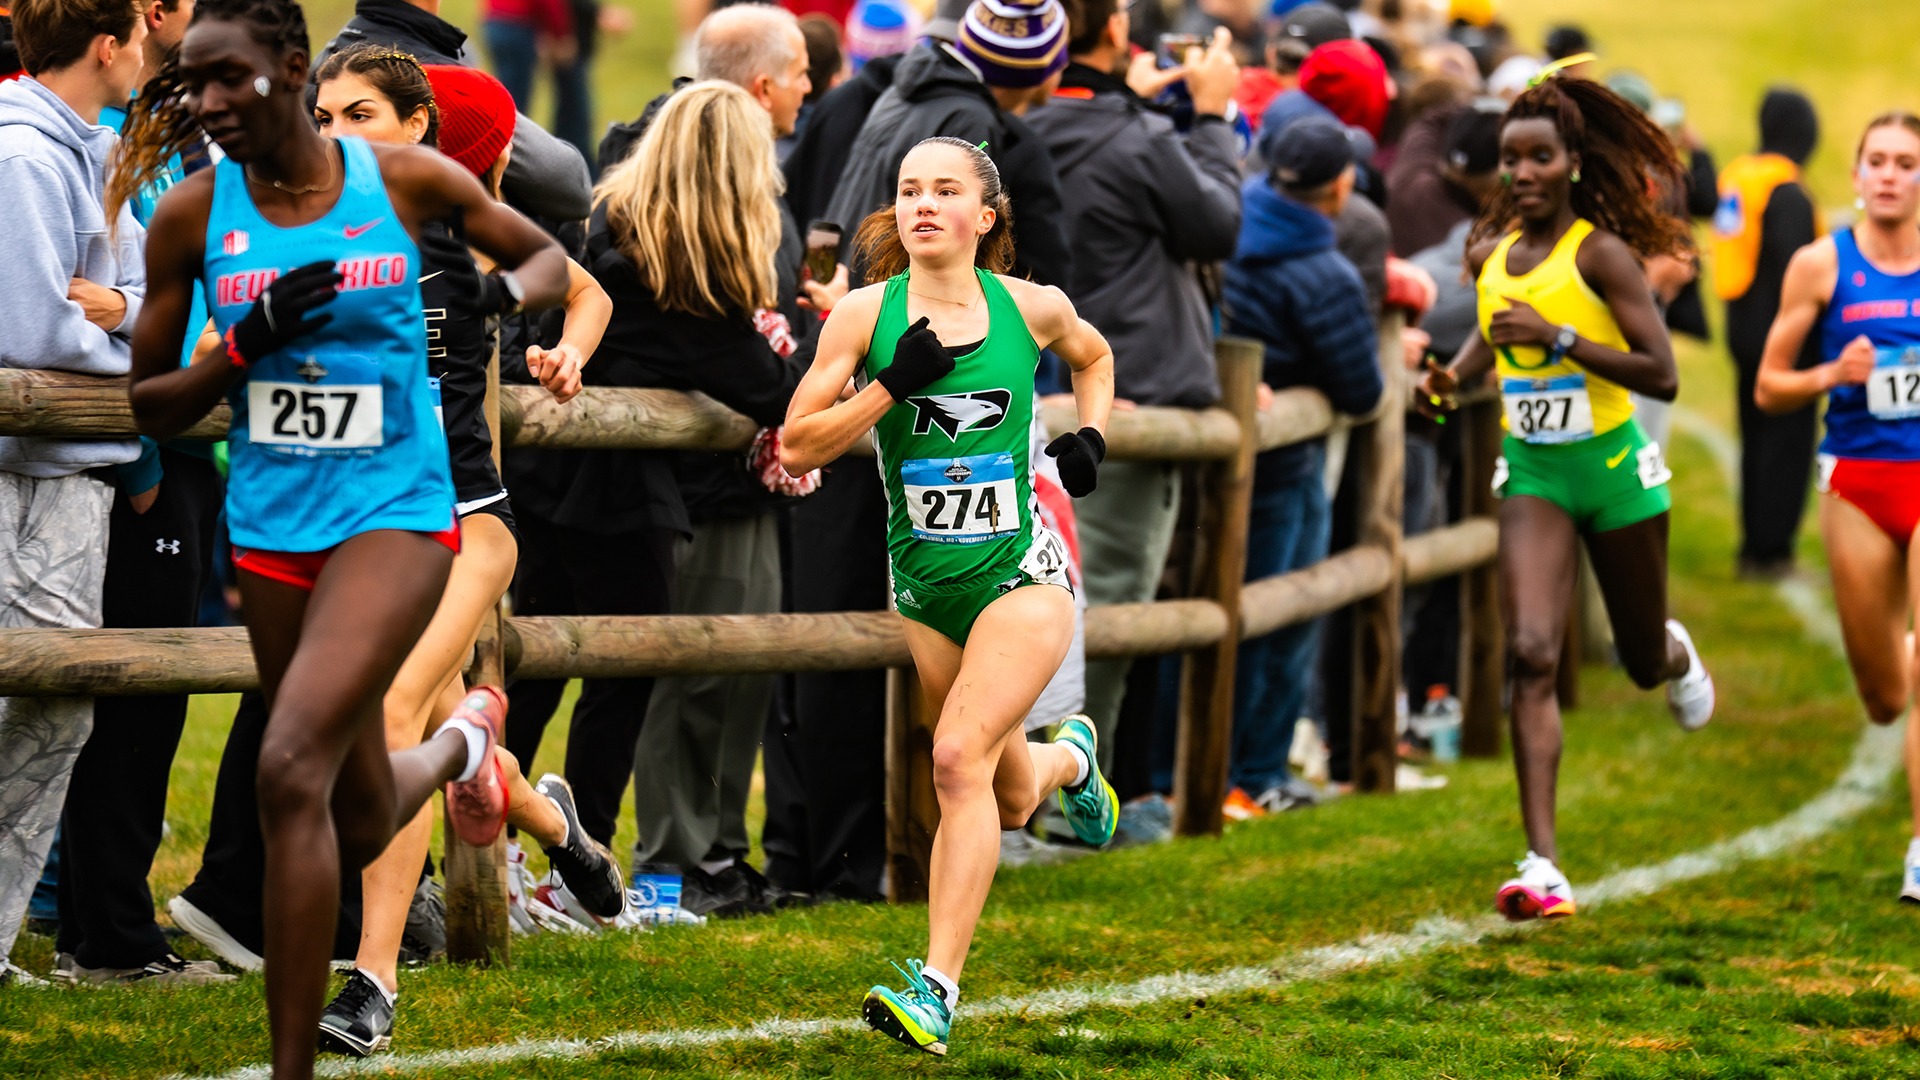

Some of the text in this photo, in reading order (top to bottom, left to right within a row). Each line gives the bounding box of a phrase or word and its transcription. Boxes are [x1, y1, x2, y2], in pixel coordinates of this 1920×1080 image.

[271, 388, 358, 441] 257
[1517, 397, 1573, 433] 327
[921, 486, 1001, 530] 274
